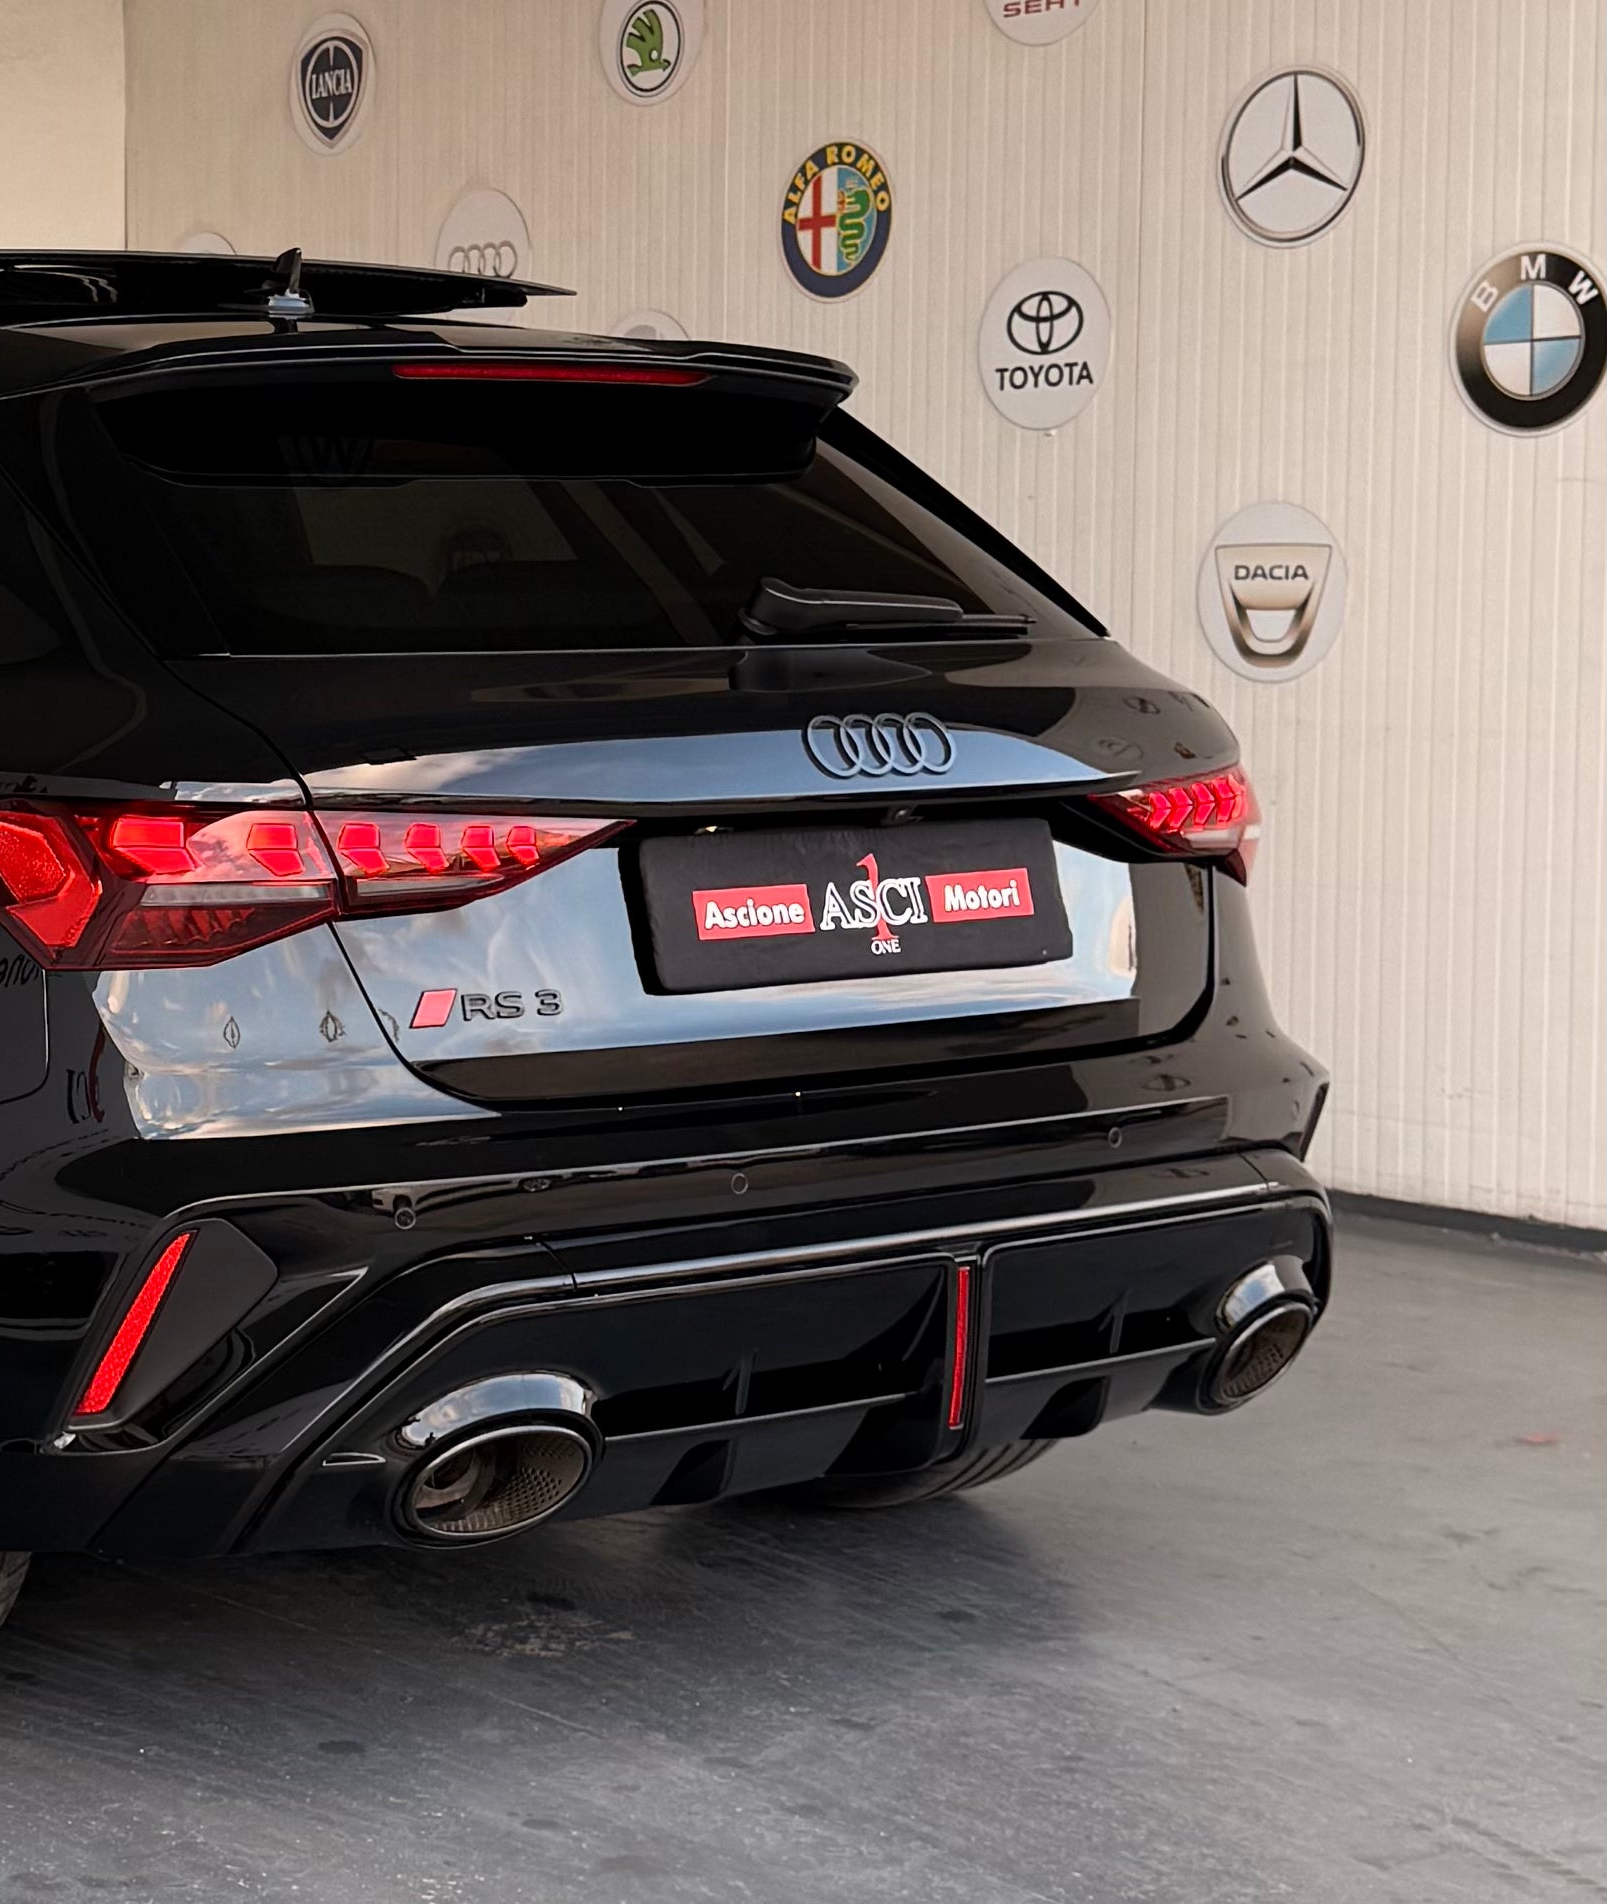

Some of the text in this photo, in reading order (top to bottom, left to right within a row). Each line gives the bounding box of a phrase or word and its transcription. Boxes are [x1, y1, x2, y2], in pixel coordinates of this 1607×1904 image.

[311, 68, 352, 99] LANCIA
[782, 145, 890, 225] ALFA ROMEO
[1471, 253, 1599, 314] BMW
[994, 360, 1094, 391] TOYOTA
[1234, 564, 1309, 581] DACIA
[819, 877, 929, 932] ASCI
[944, 879, 1021, 913] Motori
[704, 898, 805, 930] Ascione
[870, 938, 902, 956] ONE
[460, 988, 563, 1022] RS 3
